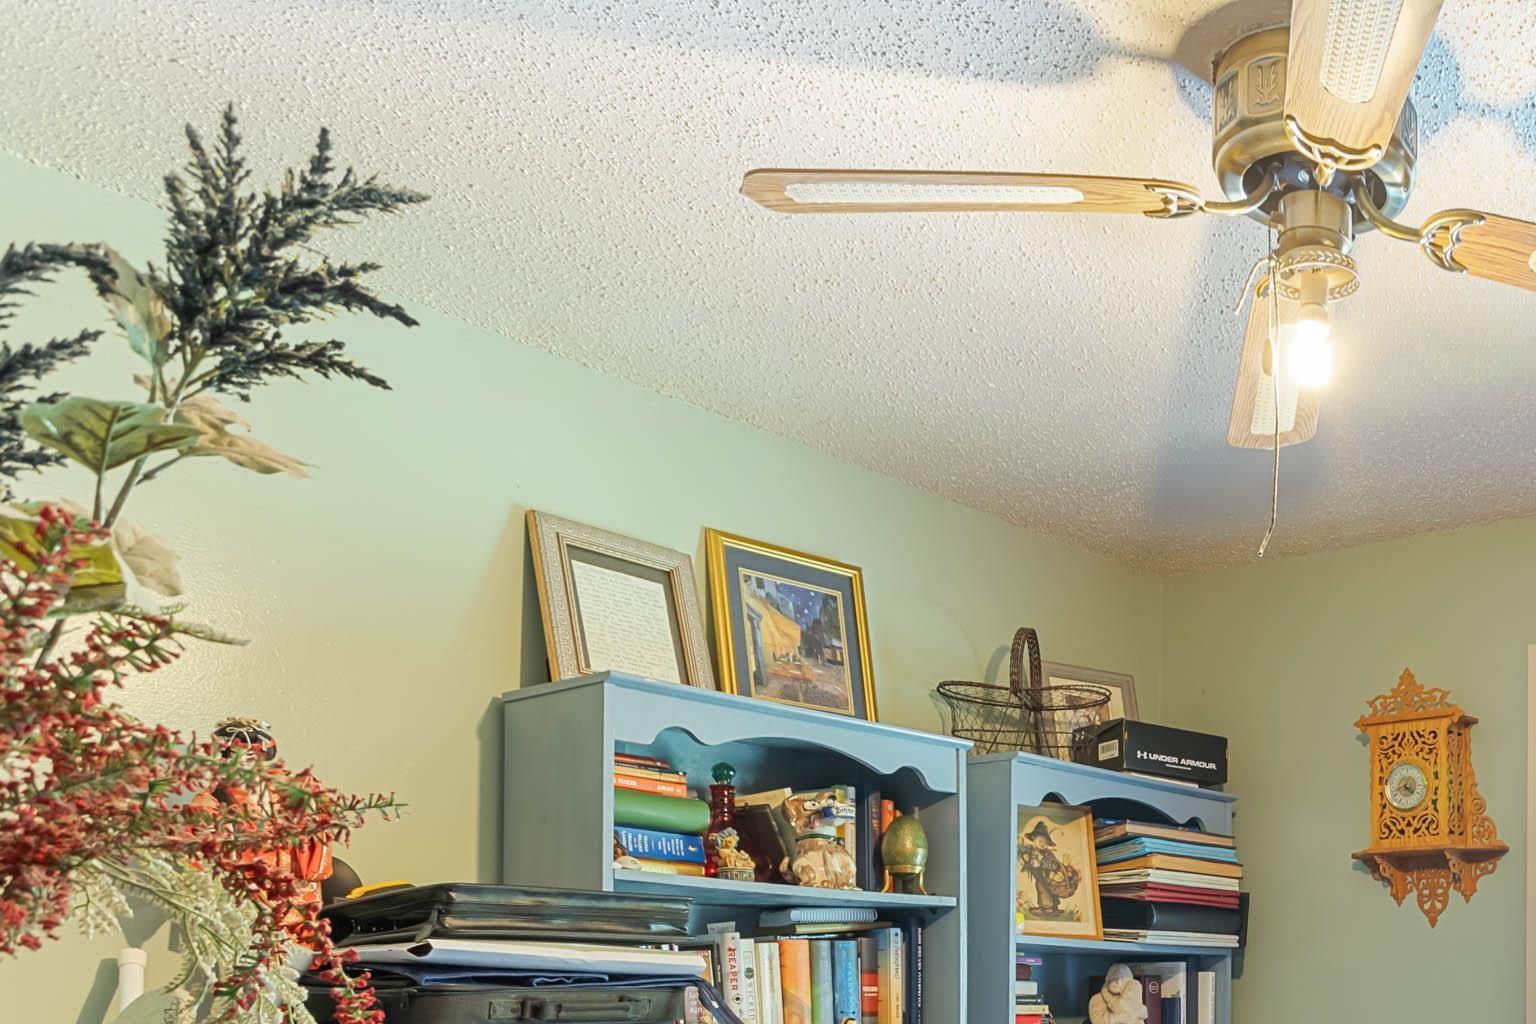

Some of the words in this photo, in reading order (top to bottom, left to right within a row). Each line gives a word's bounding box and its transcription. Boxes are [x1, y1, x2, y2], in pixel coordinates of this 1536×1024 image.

[1148, 753, 1179, 764] UNDER
[1180, 758, 1217, 770] ARMOUR
[727, 946, 738, 991] REAPER
